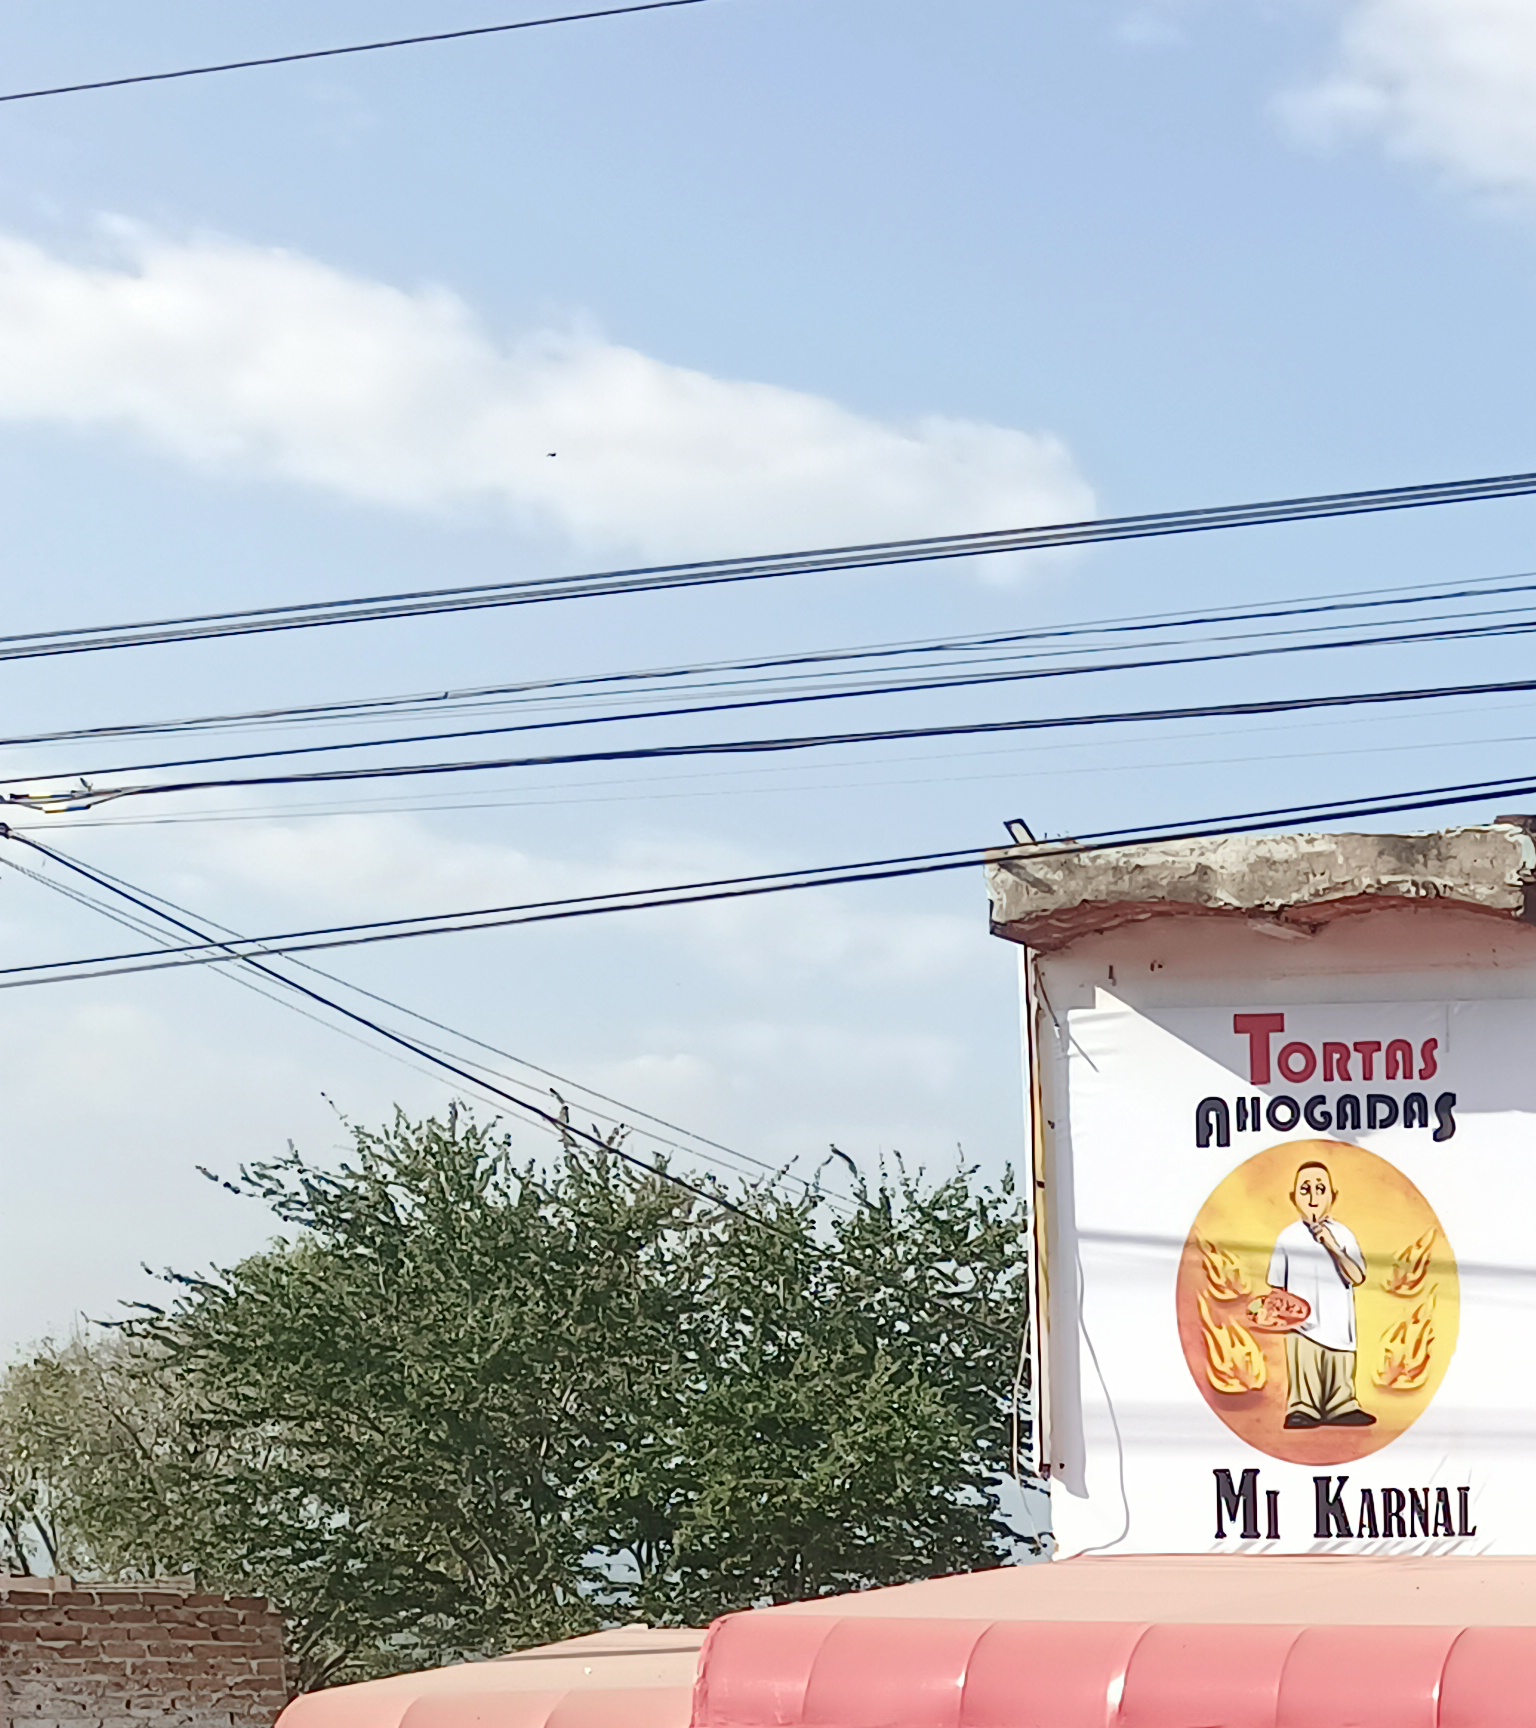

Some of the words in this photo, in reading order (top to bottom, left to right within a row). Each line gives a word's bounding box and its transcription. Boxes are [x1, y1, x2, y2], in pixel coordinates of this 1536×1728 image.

[1233, 1012, 1439, 1086] TORTAS
[1195, 1092, 1457, 1148] AHOGADAS
[1313, 1475, 1477, 1540] KARNAL
